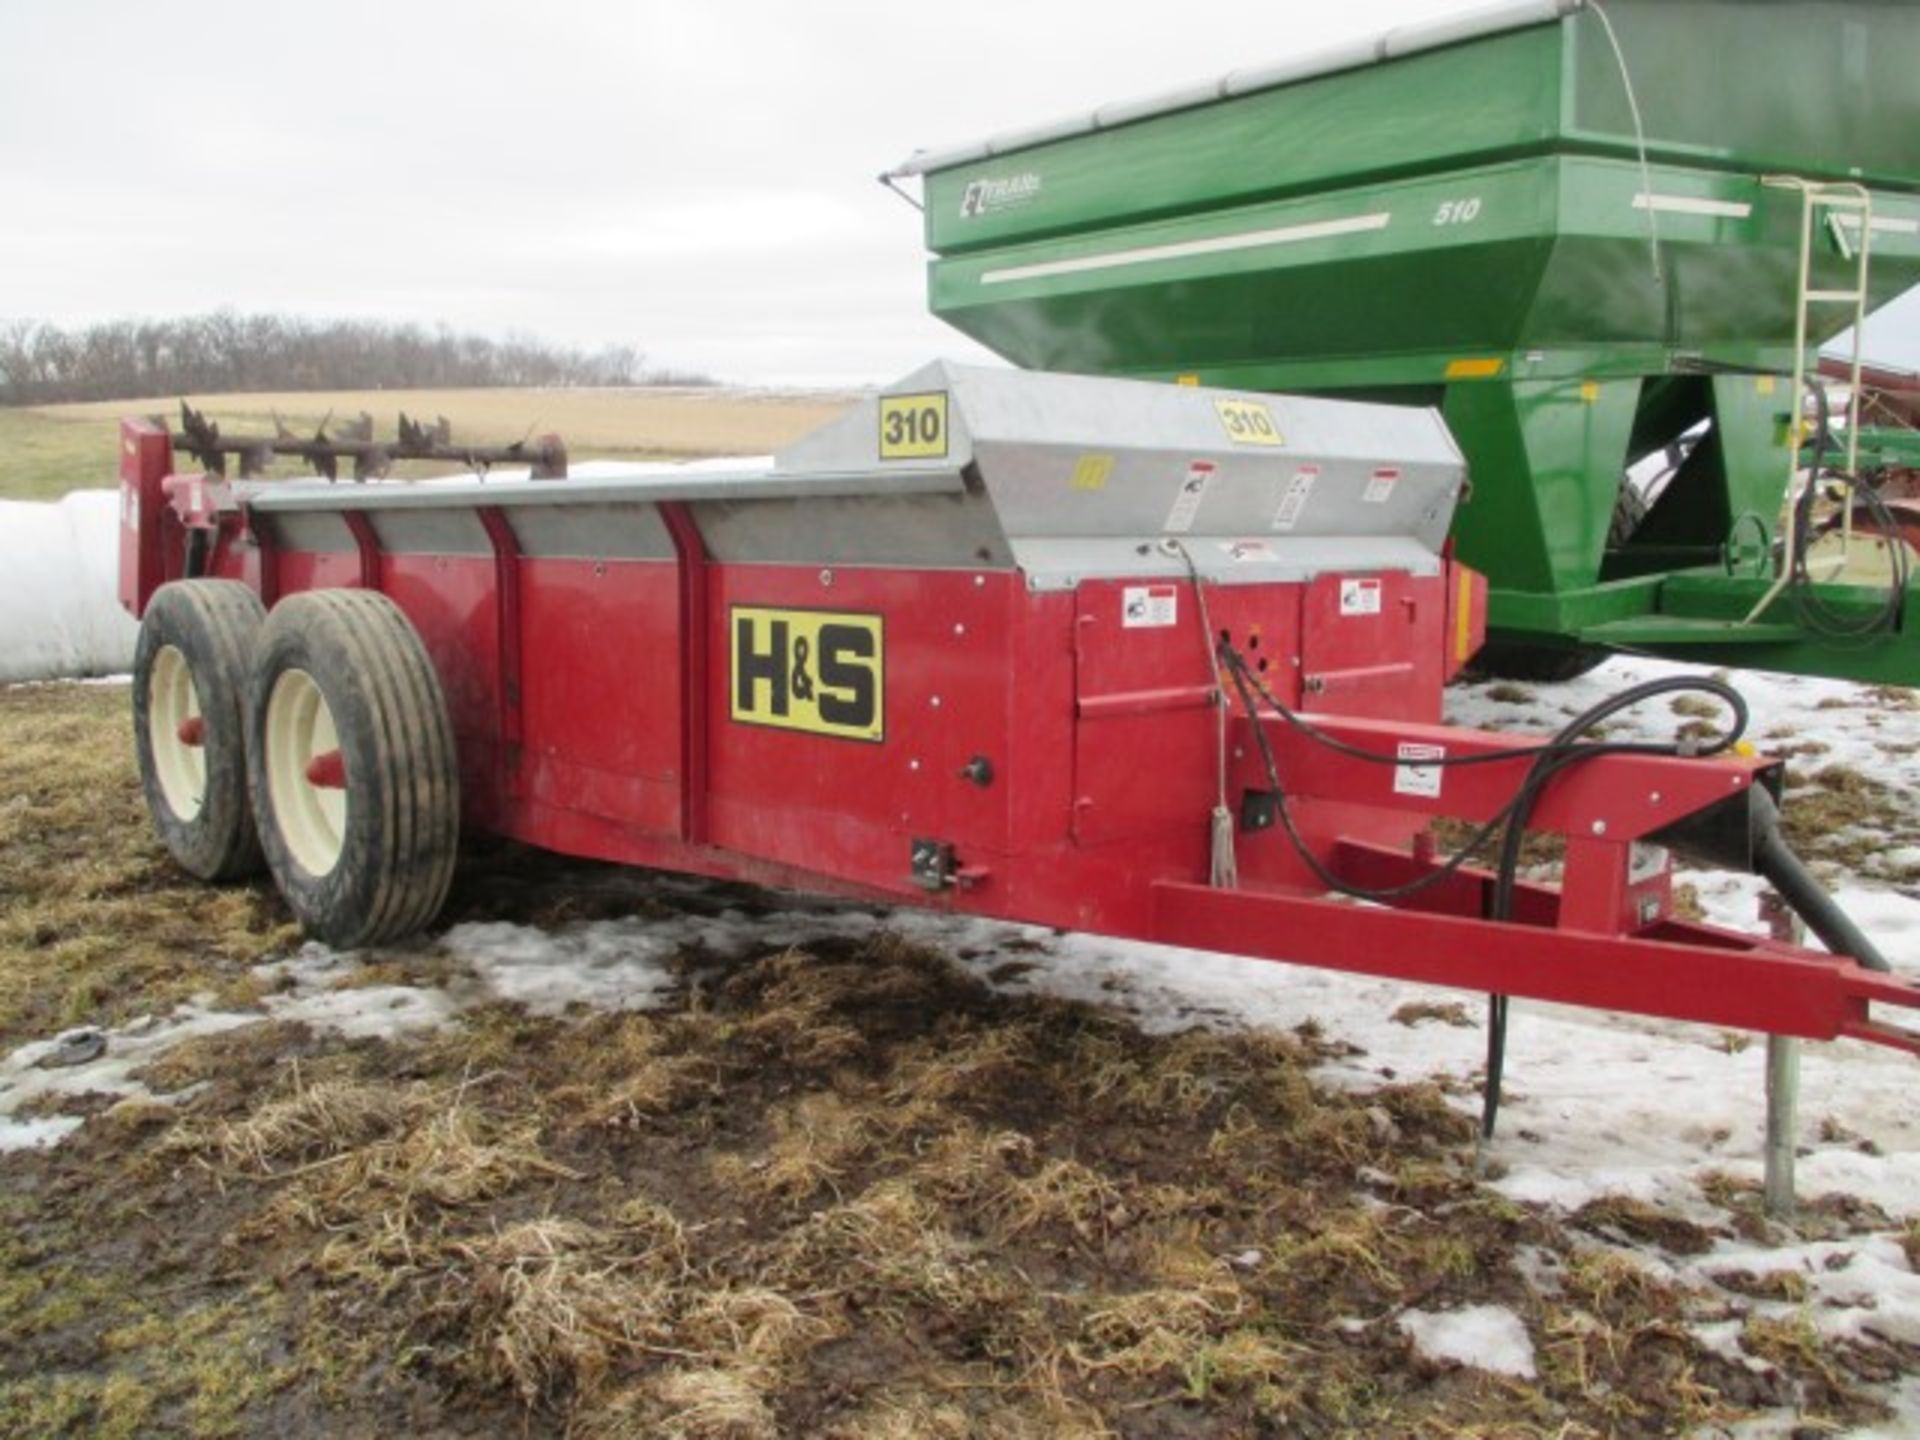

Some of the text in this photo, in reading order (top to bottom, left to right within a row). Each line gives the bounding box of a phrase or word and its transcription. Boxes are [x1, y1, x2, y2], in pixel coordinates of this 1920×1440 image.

[1433, 197, 1481, 226] 510
[885, 407, 939, 445] 310
[1223, 407, 1273, 436] 310
[737, 617, 875, 727] H&S
